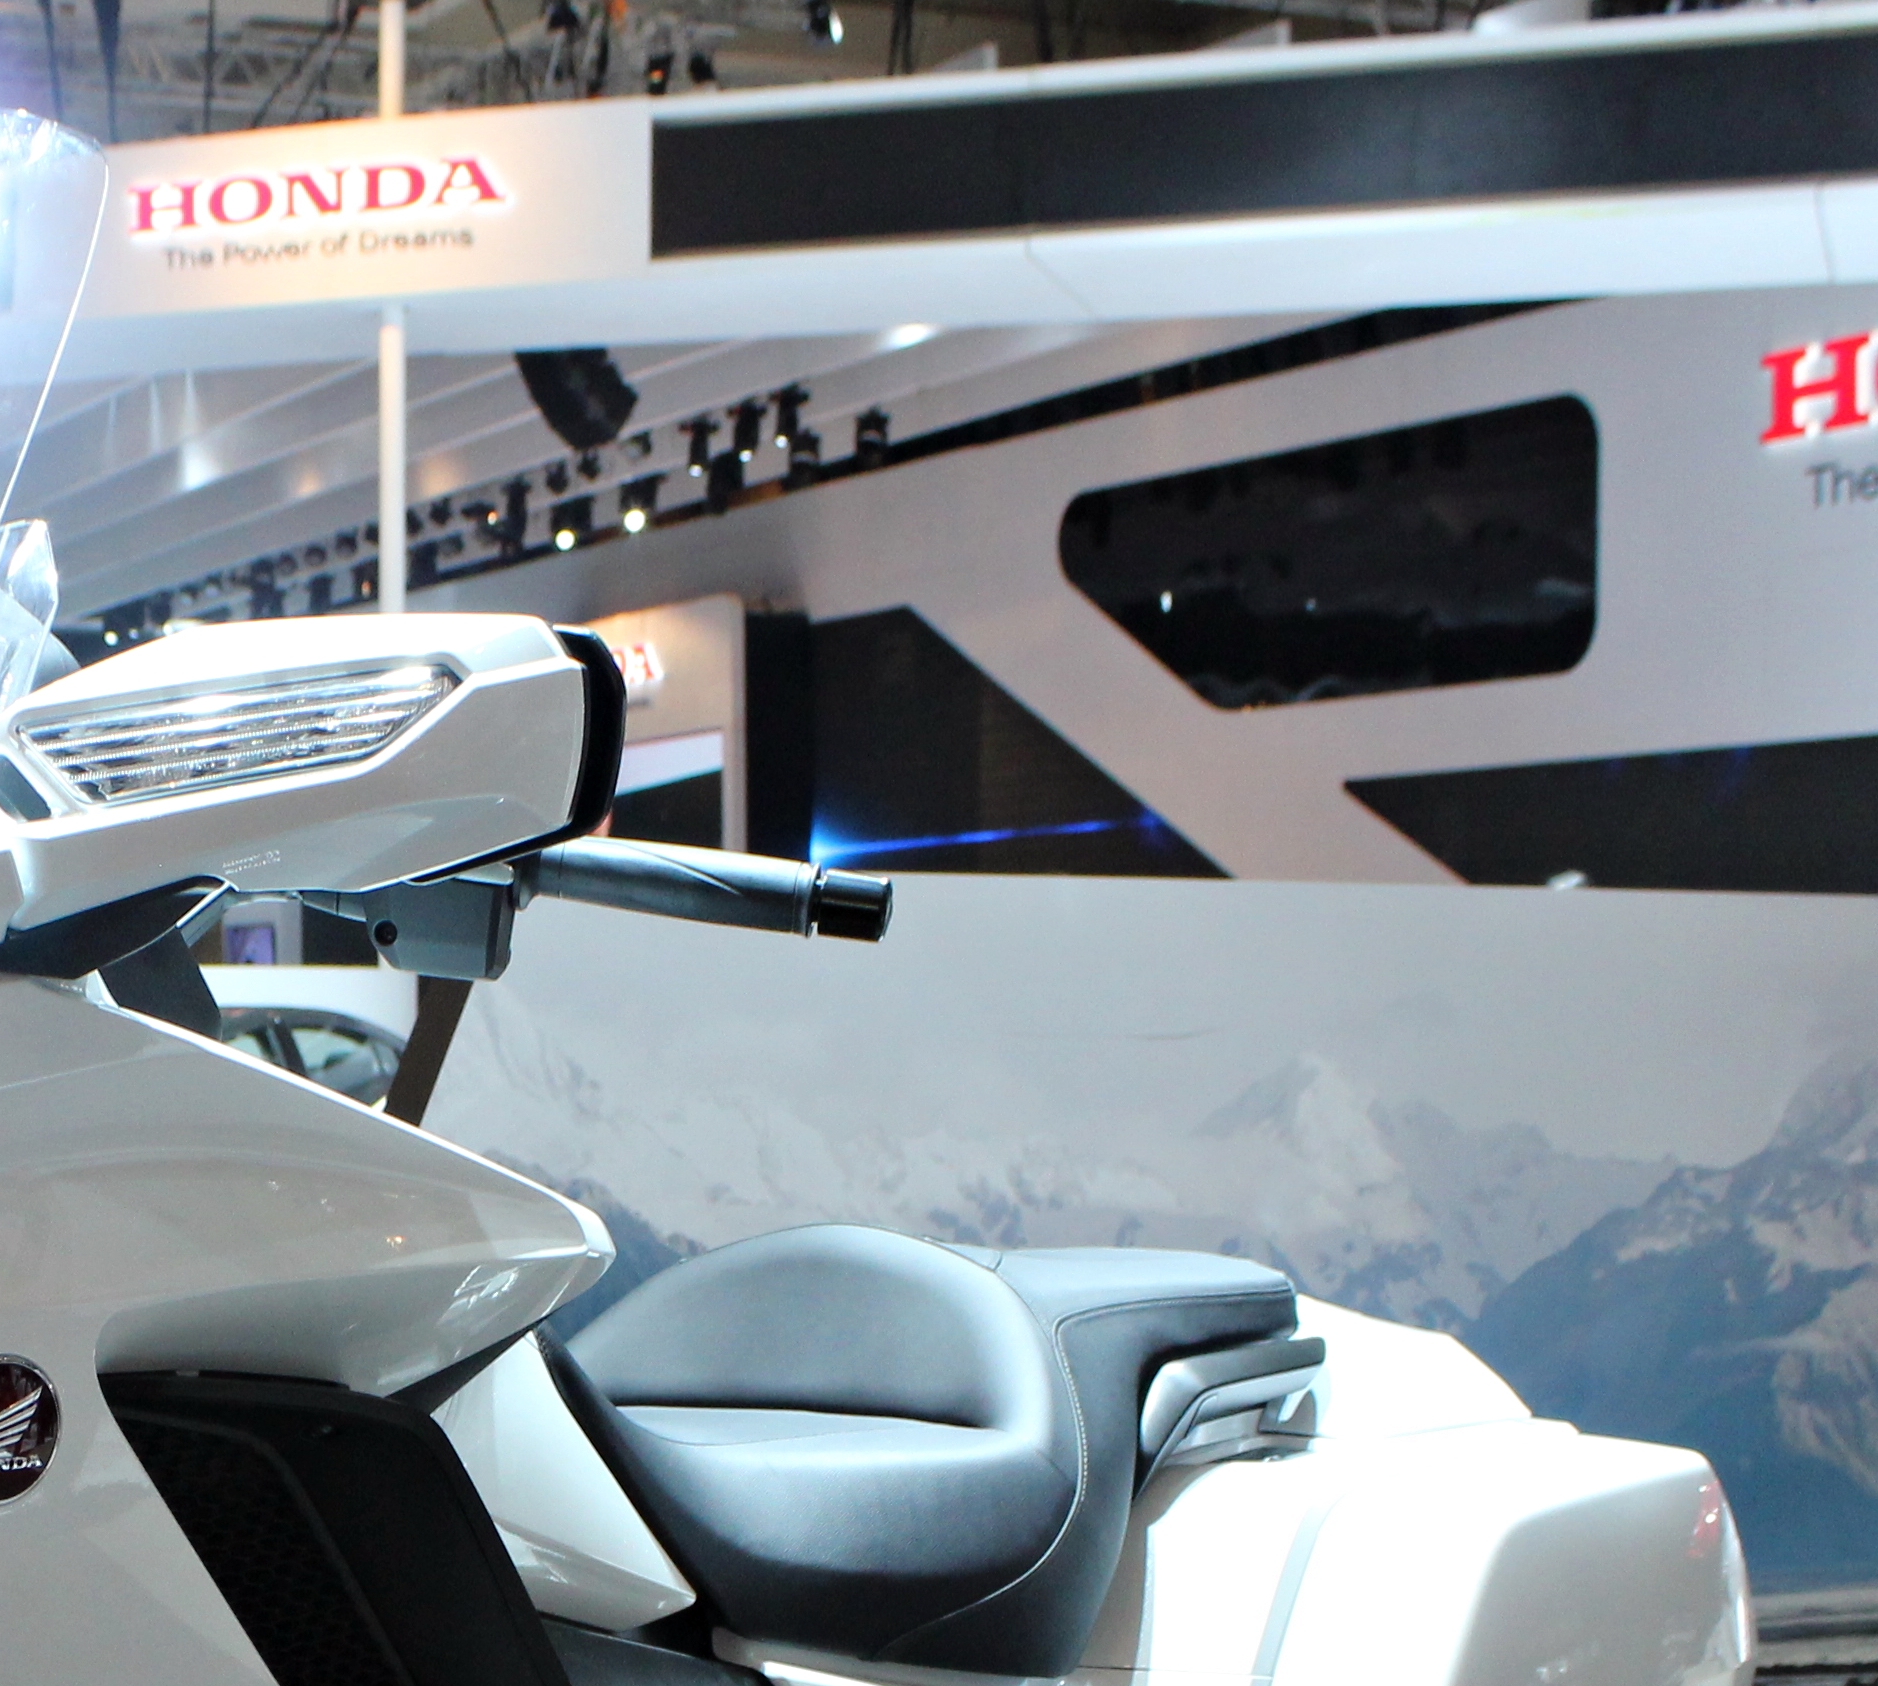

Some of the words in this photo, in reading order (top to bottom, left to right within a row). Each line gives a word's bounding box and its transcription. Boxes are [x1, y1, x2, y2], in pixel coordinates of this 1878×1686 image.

[127, 156, 506, 234] HONDA
[164, 246, 213, 270] The
[223, 239, 312, 266] Power
[321, 231, 349, 253] of
[358, 226, 474, 251] Dreams
[1759, 330, 1878, 446] H
